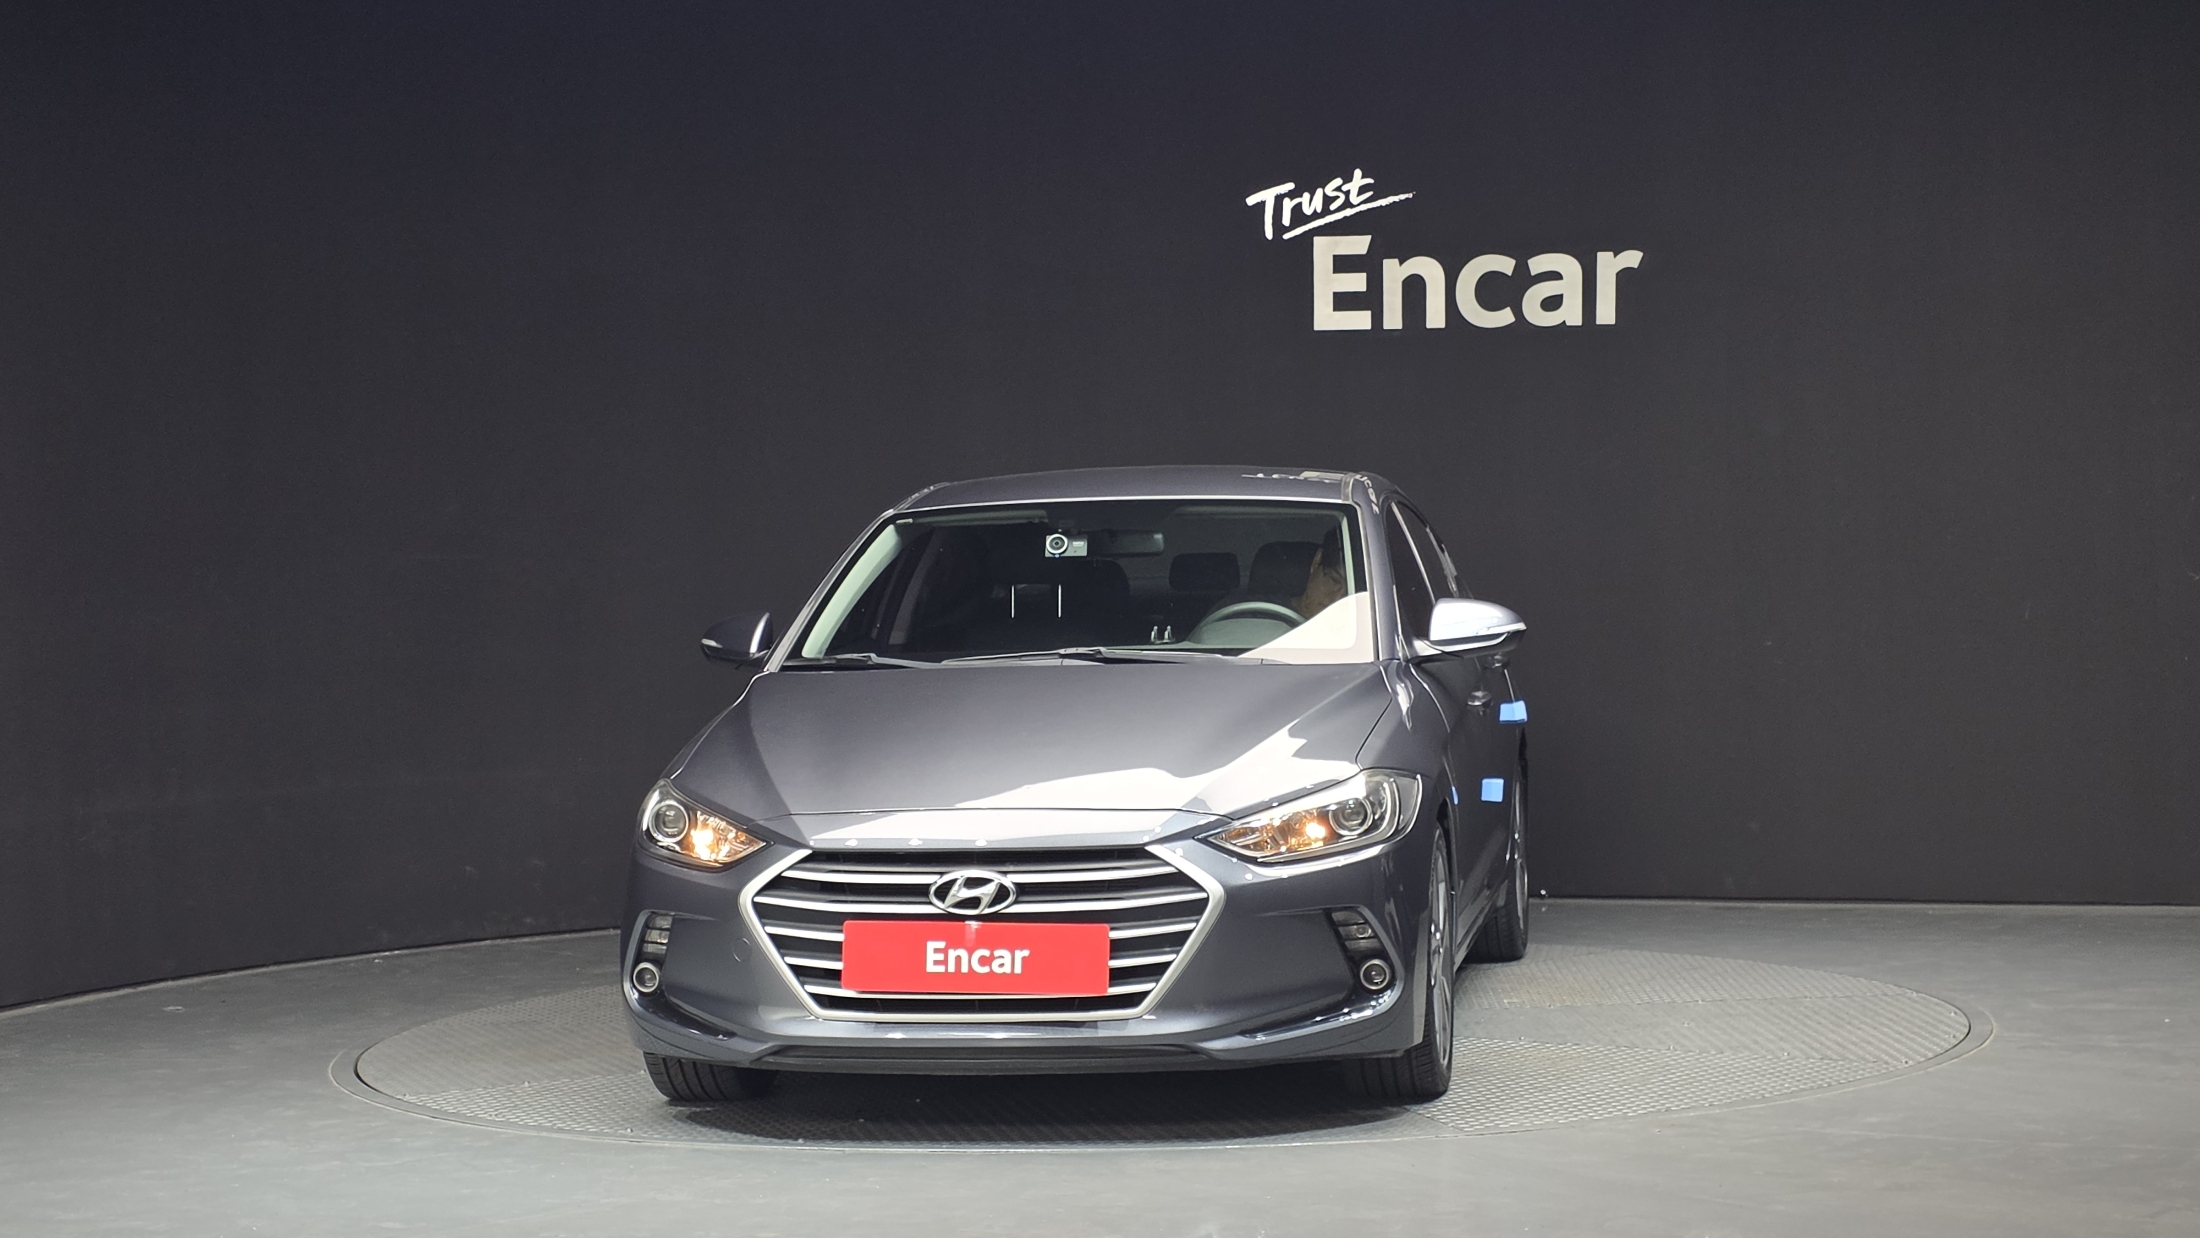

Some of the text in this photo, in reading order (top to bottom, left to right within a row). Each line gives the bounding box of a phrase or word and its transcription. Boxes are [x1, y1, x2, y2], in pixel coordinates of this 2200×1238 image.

[1245, 167, 1376, 240] Trust
[1312, 234, 1644, 331] Encar
[925, 940, 1030, 974] Encar
